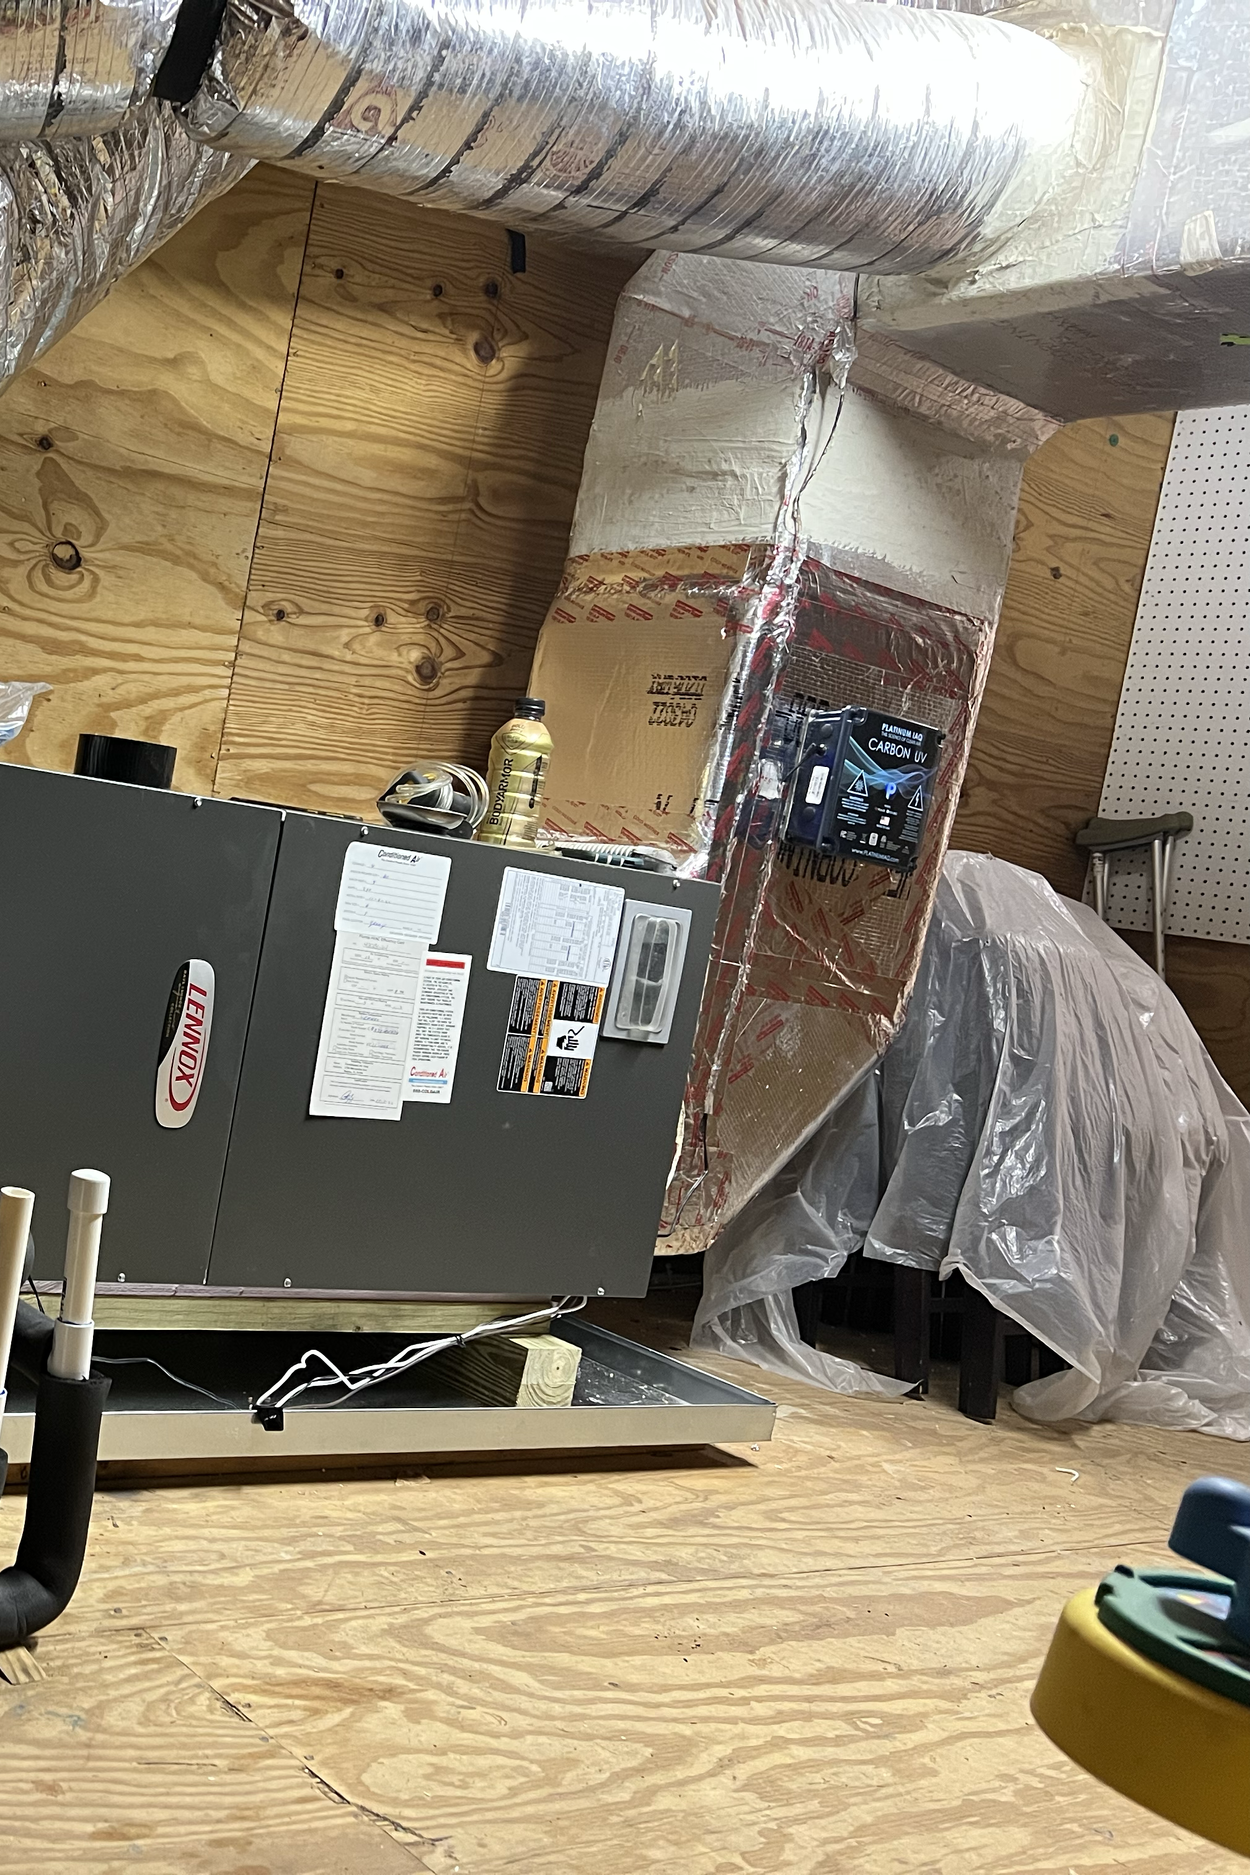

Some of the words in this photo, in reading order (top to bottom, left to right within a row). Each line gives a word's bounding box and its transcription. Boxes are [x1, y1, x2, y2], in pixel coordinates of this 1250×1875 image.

[868, 737, 911, 759] CARBON
[914, 750, 928, 764] UV
[881, 723, 912, 737] PLATINUM
[490, 758, 514, 825] BODYARMOR
[175, 982, 208, 1088] LENNOX
